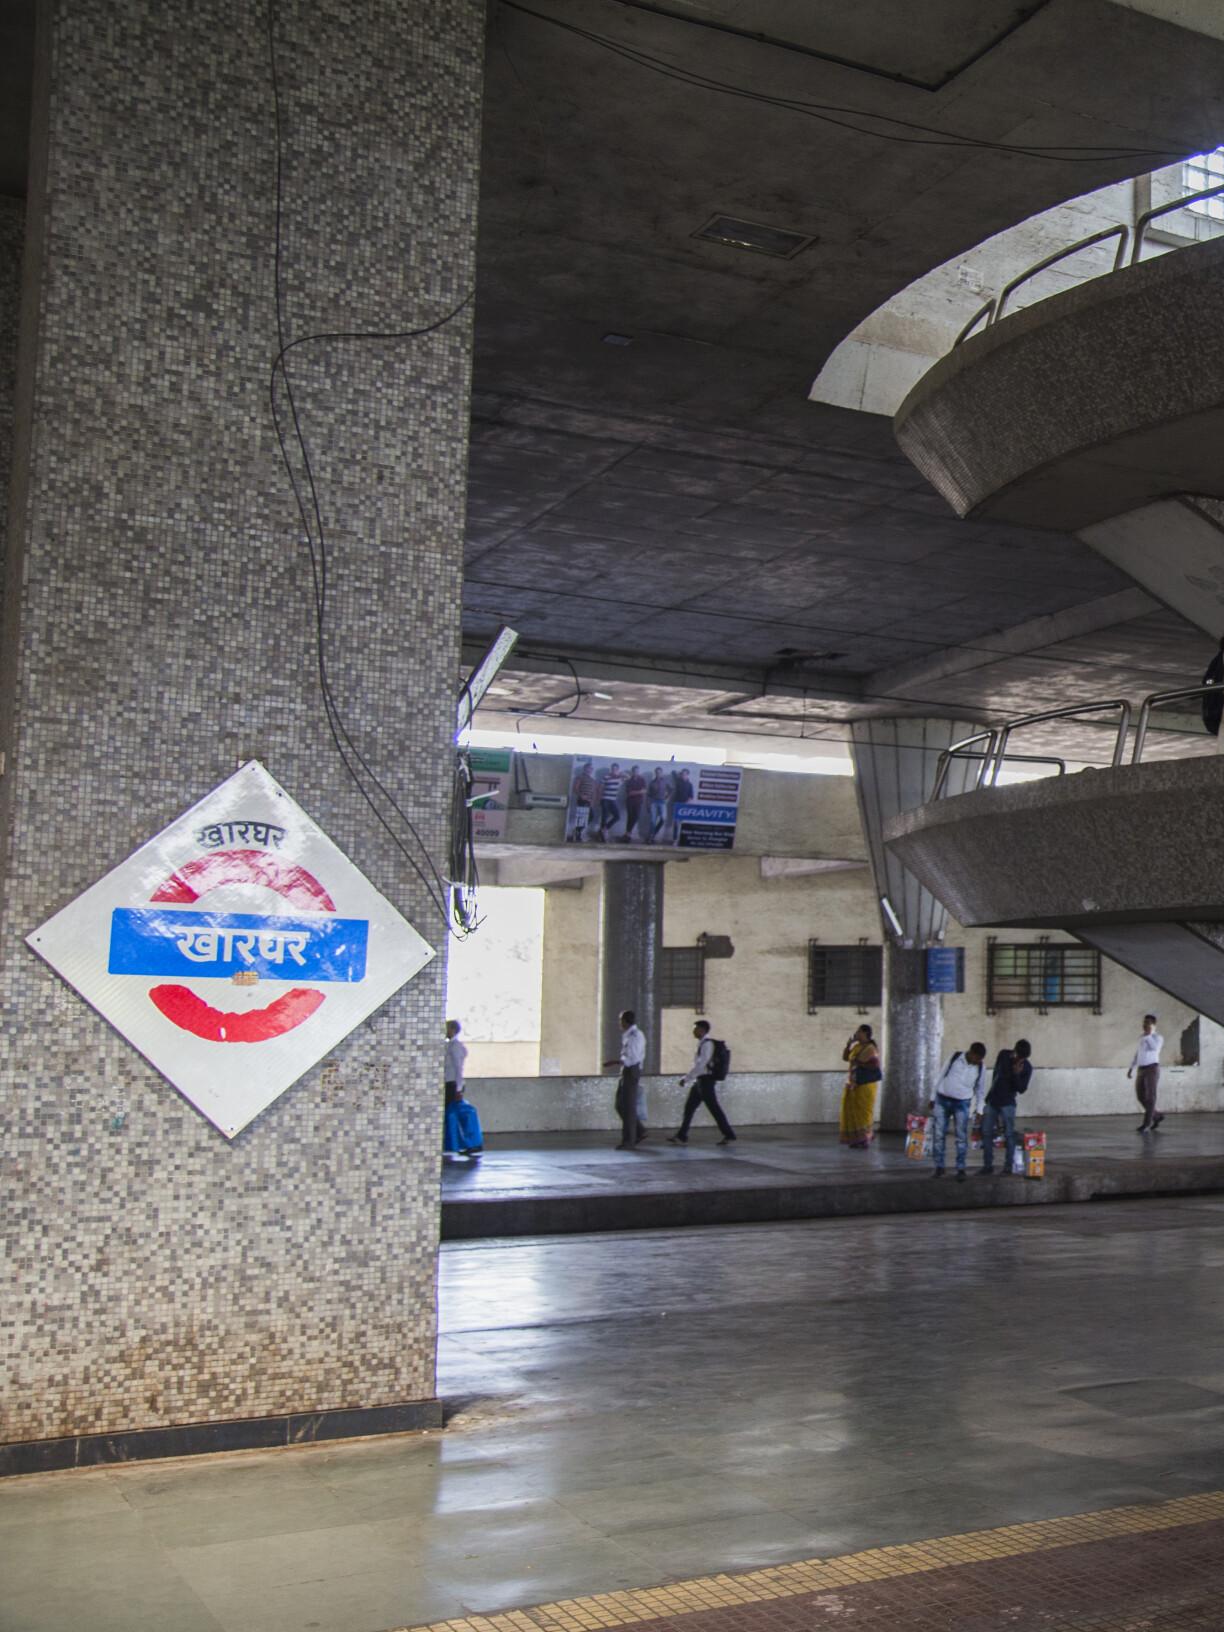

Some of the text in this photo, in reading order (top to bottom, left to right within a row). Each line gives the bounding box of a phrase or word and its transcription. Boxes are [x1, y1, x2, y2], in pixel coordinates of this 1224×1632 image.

[678, 807, 734, 819] GRAVITY
[195, 821, 287, 850] खारघर
[175, 926, 310, 966] खारघर
